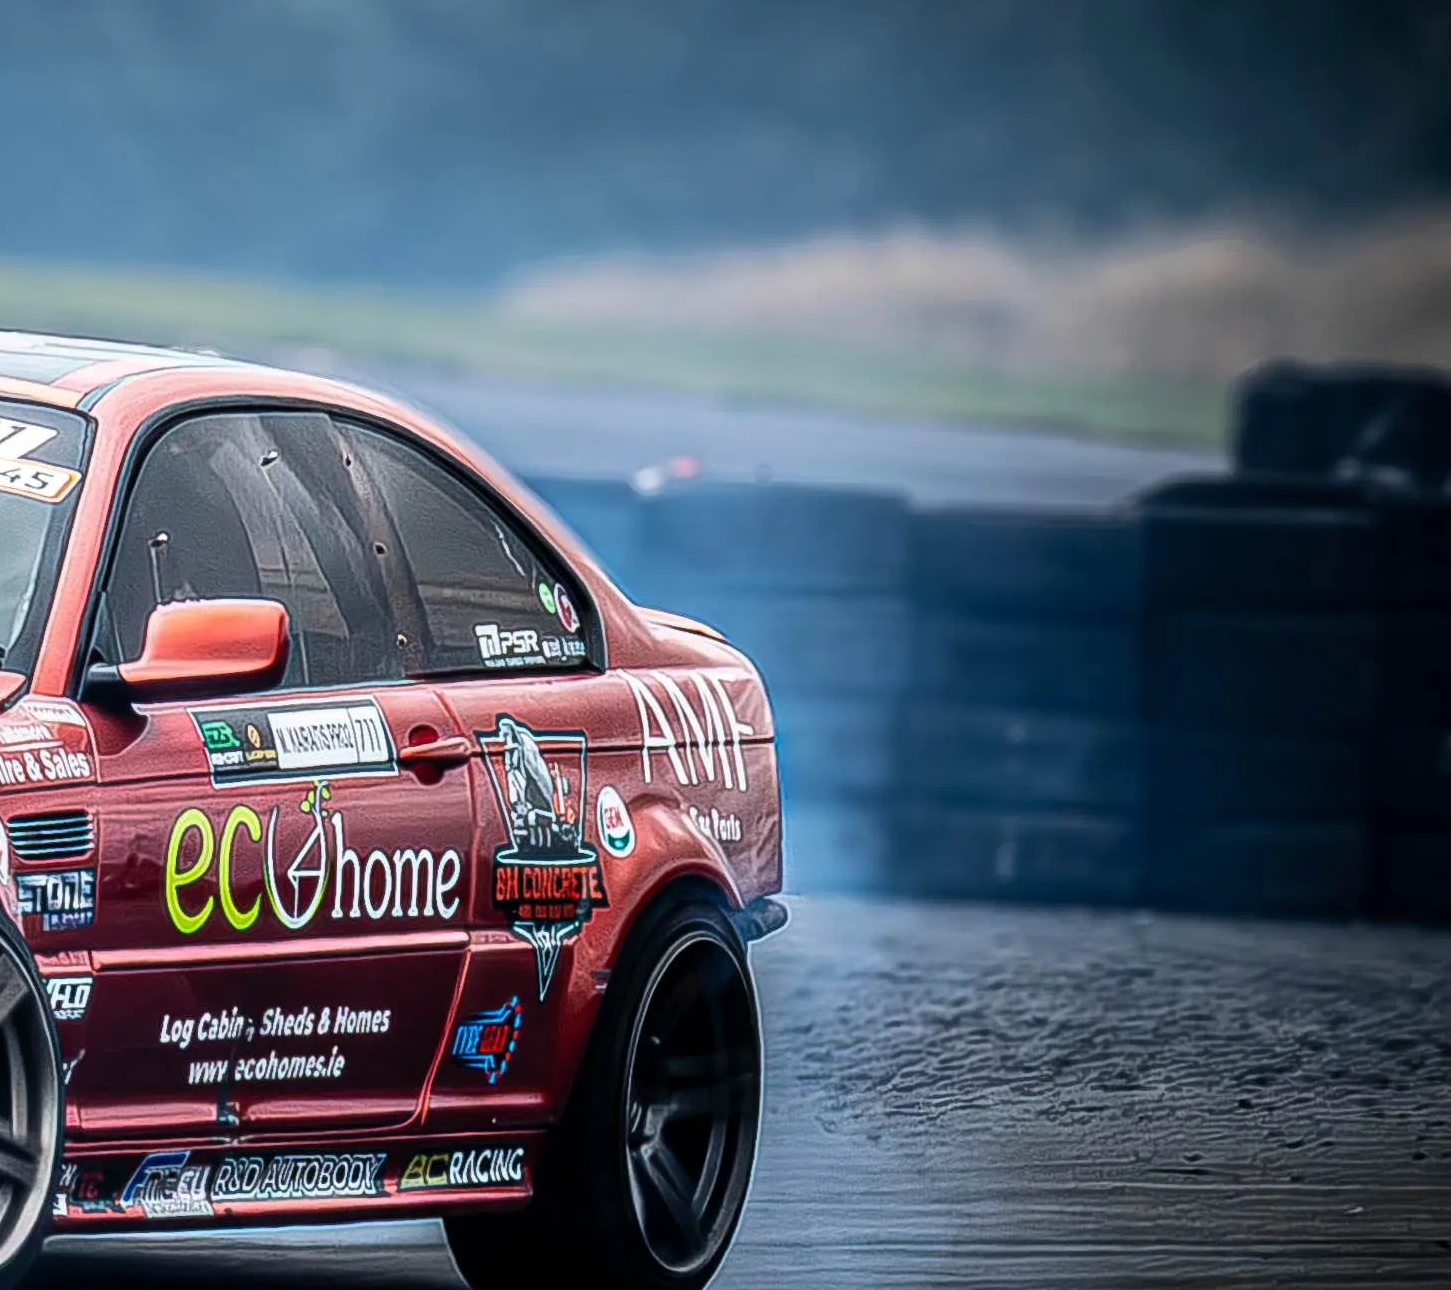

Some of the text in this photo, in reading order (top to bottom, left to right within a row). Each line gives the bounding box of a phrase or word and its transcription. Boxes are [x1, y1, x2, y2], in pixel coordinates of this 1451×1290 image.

[616, 668, 754, 793] AMF
[23, 751, 45, 782] &
[39, 747, 91, 781] Sales
[496, 866, 603, 901] BM CONCRETE
[159, 1014, 195, 1049] Log
[259, 1006, 315, 1036] Sheds
[317, 1007, 331, 1034] &
[334, 1005, 392, 1035] Homes
[256, 1154, 387, 1199] AUTOBODY
[448, 1148, 525, 1186] RACING
